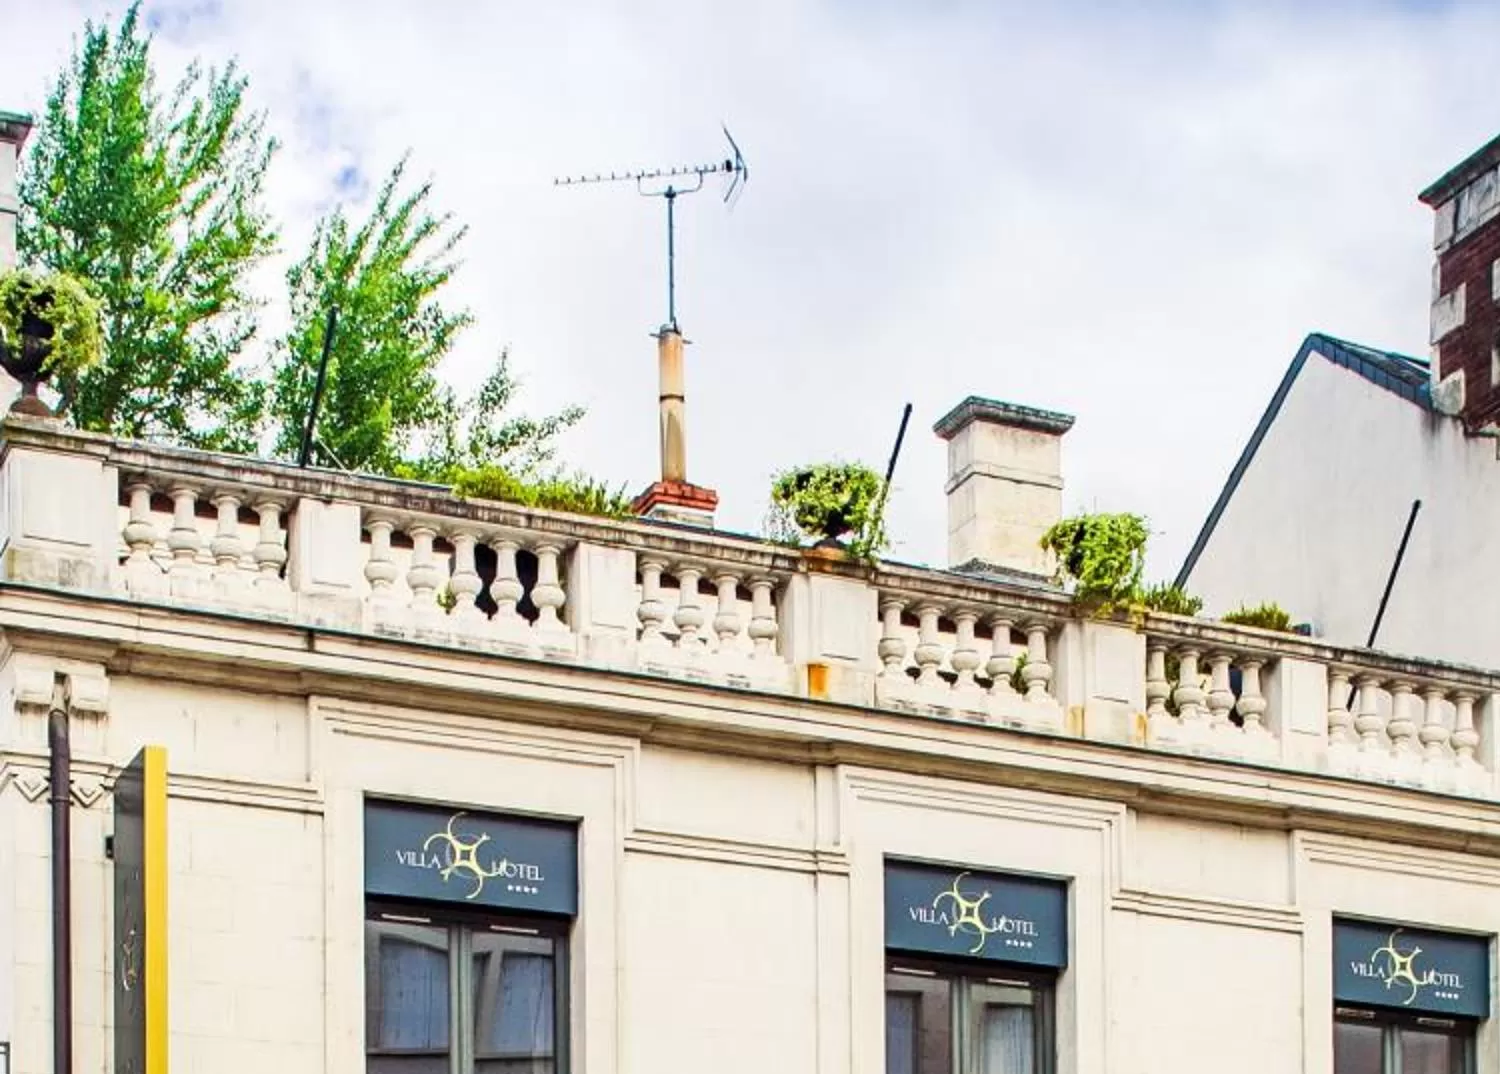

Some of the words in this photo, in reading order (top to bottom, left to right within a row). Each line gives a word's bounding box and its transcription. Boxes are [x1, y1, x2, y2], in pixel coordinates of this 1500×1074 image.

[396, 850, 441, 868] VILLA
[909, 907, 949, 925] VILLA
[1351, 961, 1385, 978] VILLA
